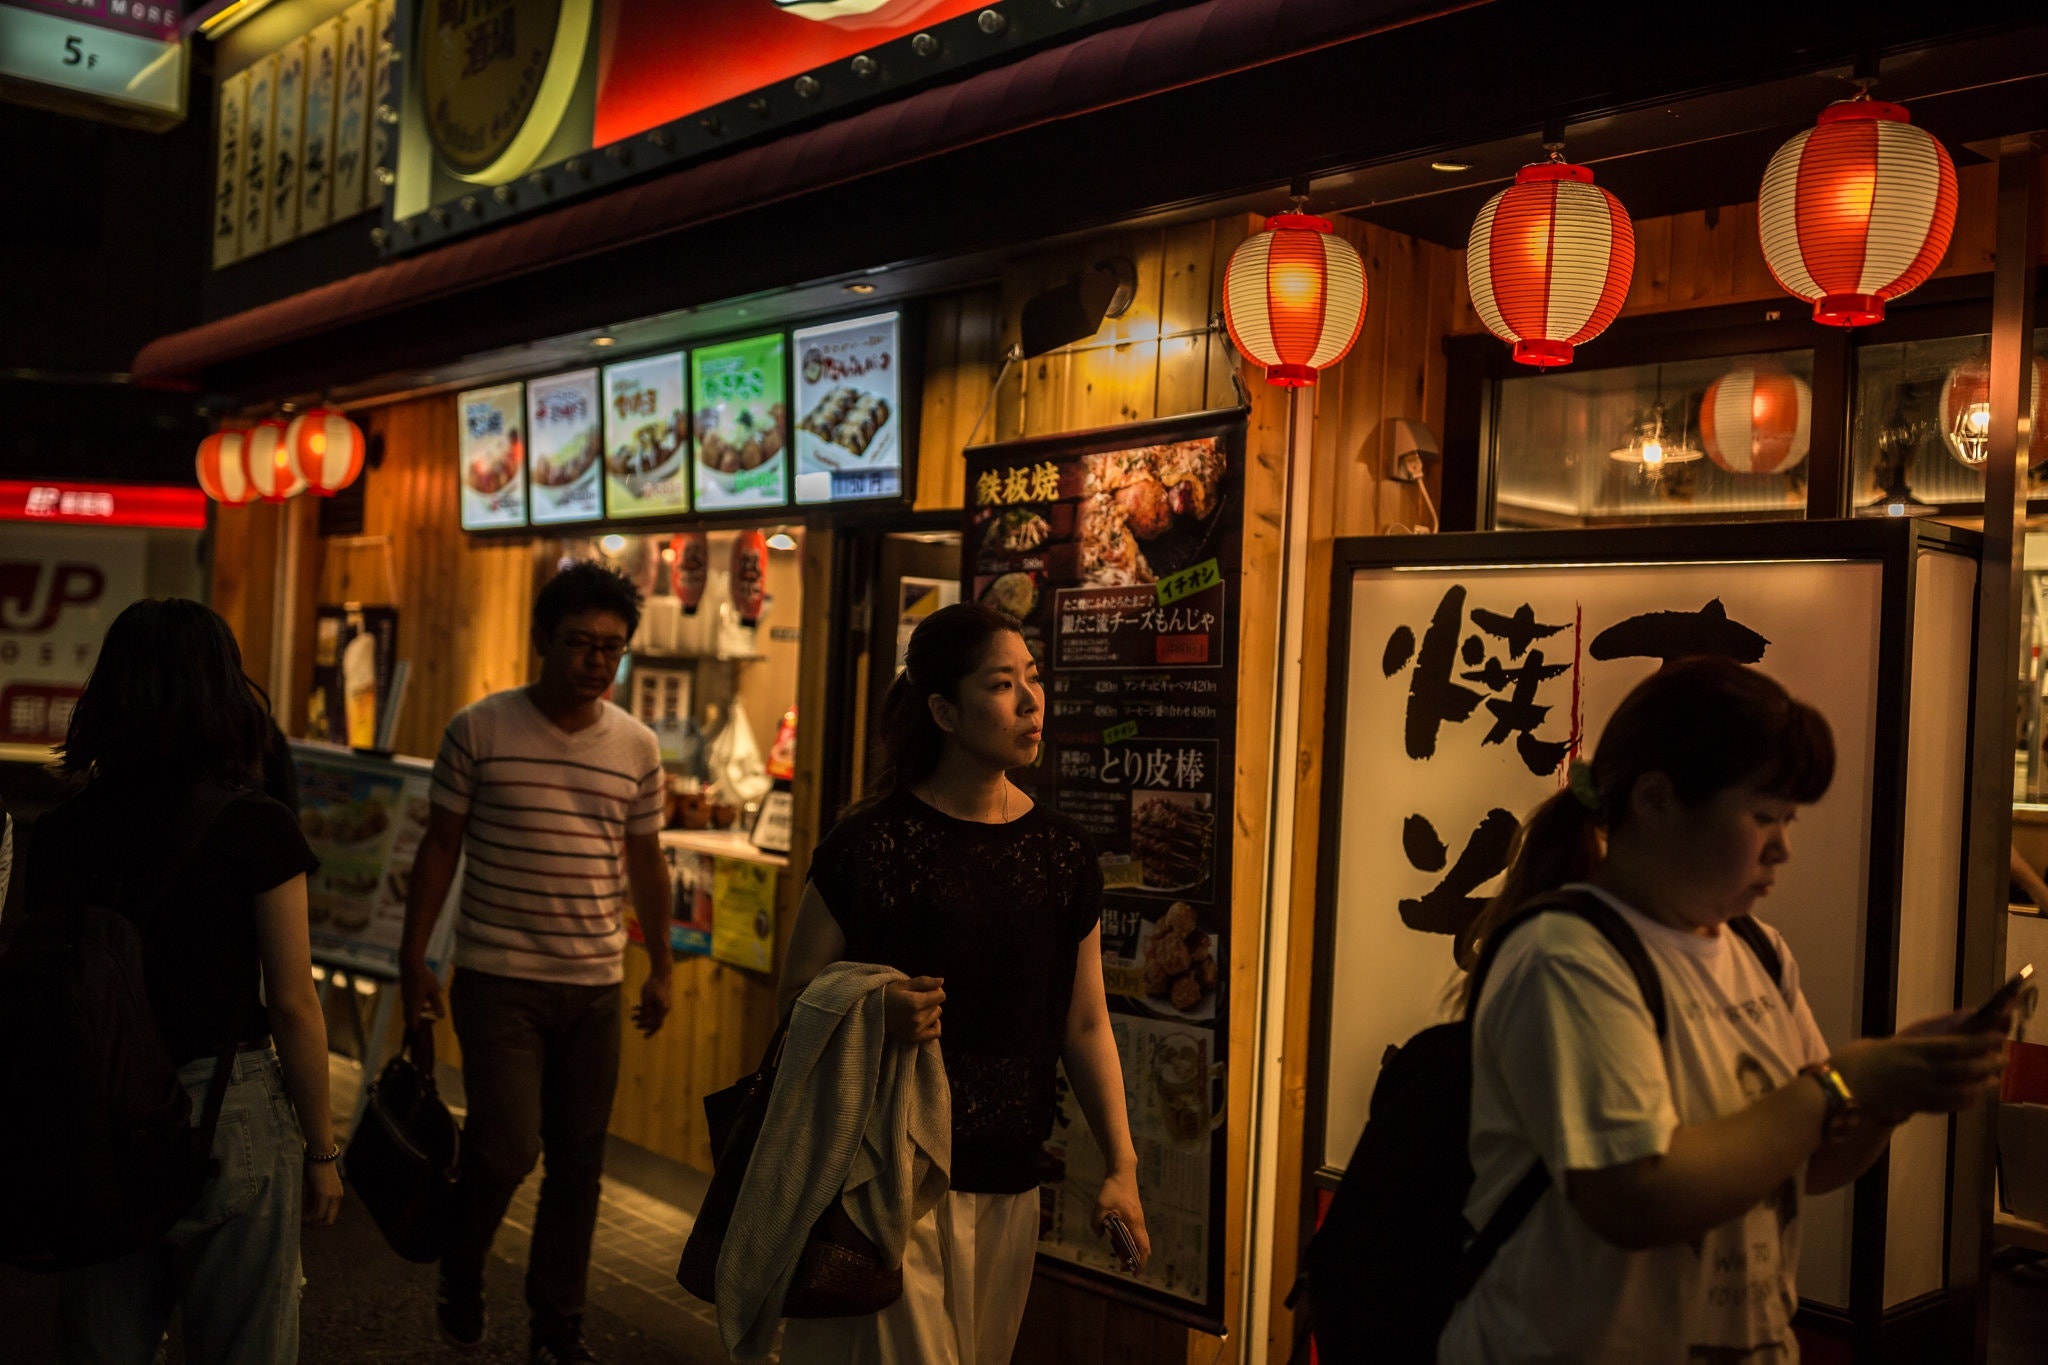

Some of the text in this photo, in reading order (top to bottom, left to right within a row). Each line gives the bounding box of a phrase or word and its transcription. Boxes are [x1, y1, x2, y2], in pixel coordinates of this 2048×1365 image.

[976, 460, 1060, 506] 鉄板焼
[1161, 567, 1216, 600] イチオシ
[1100, 747, 1205, 790] とり皮棒
